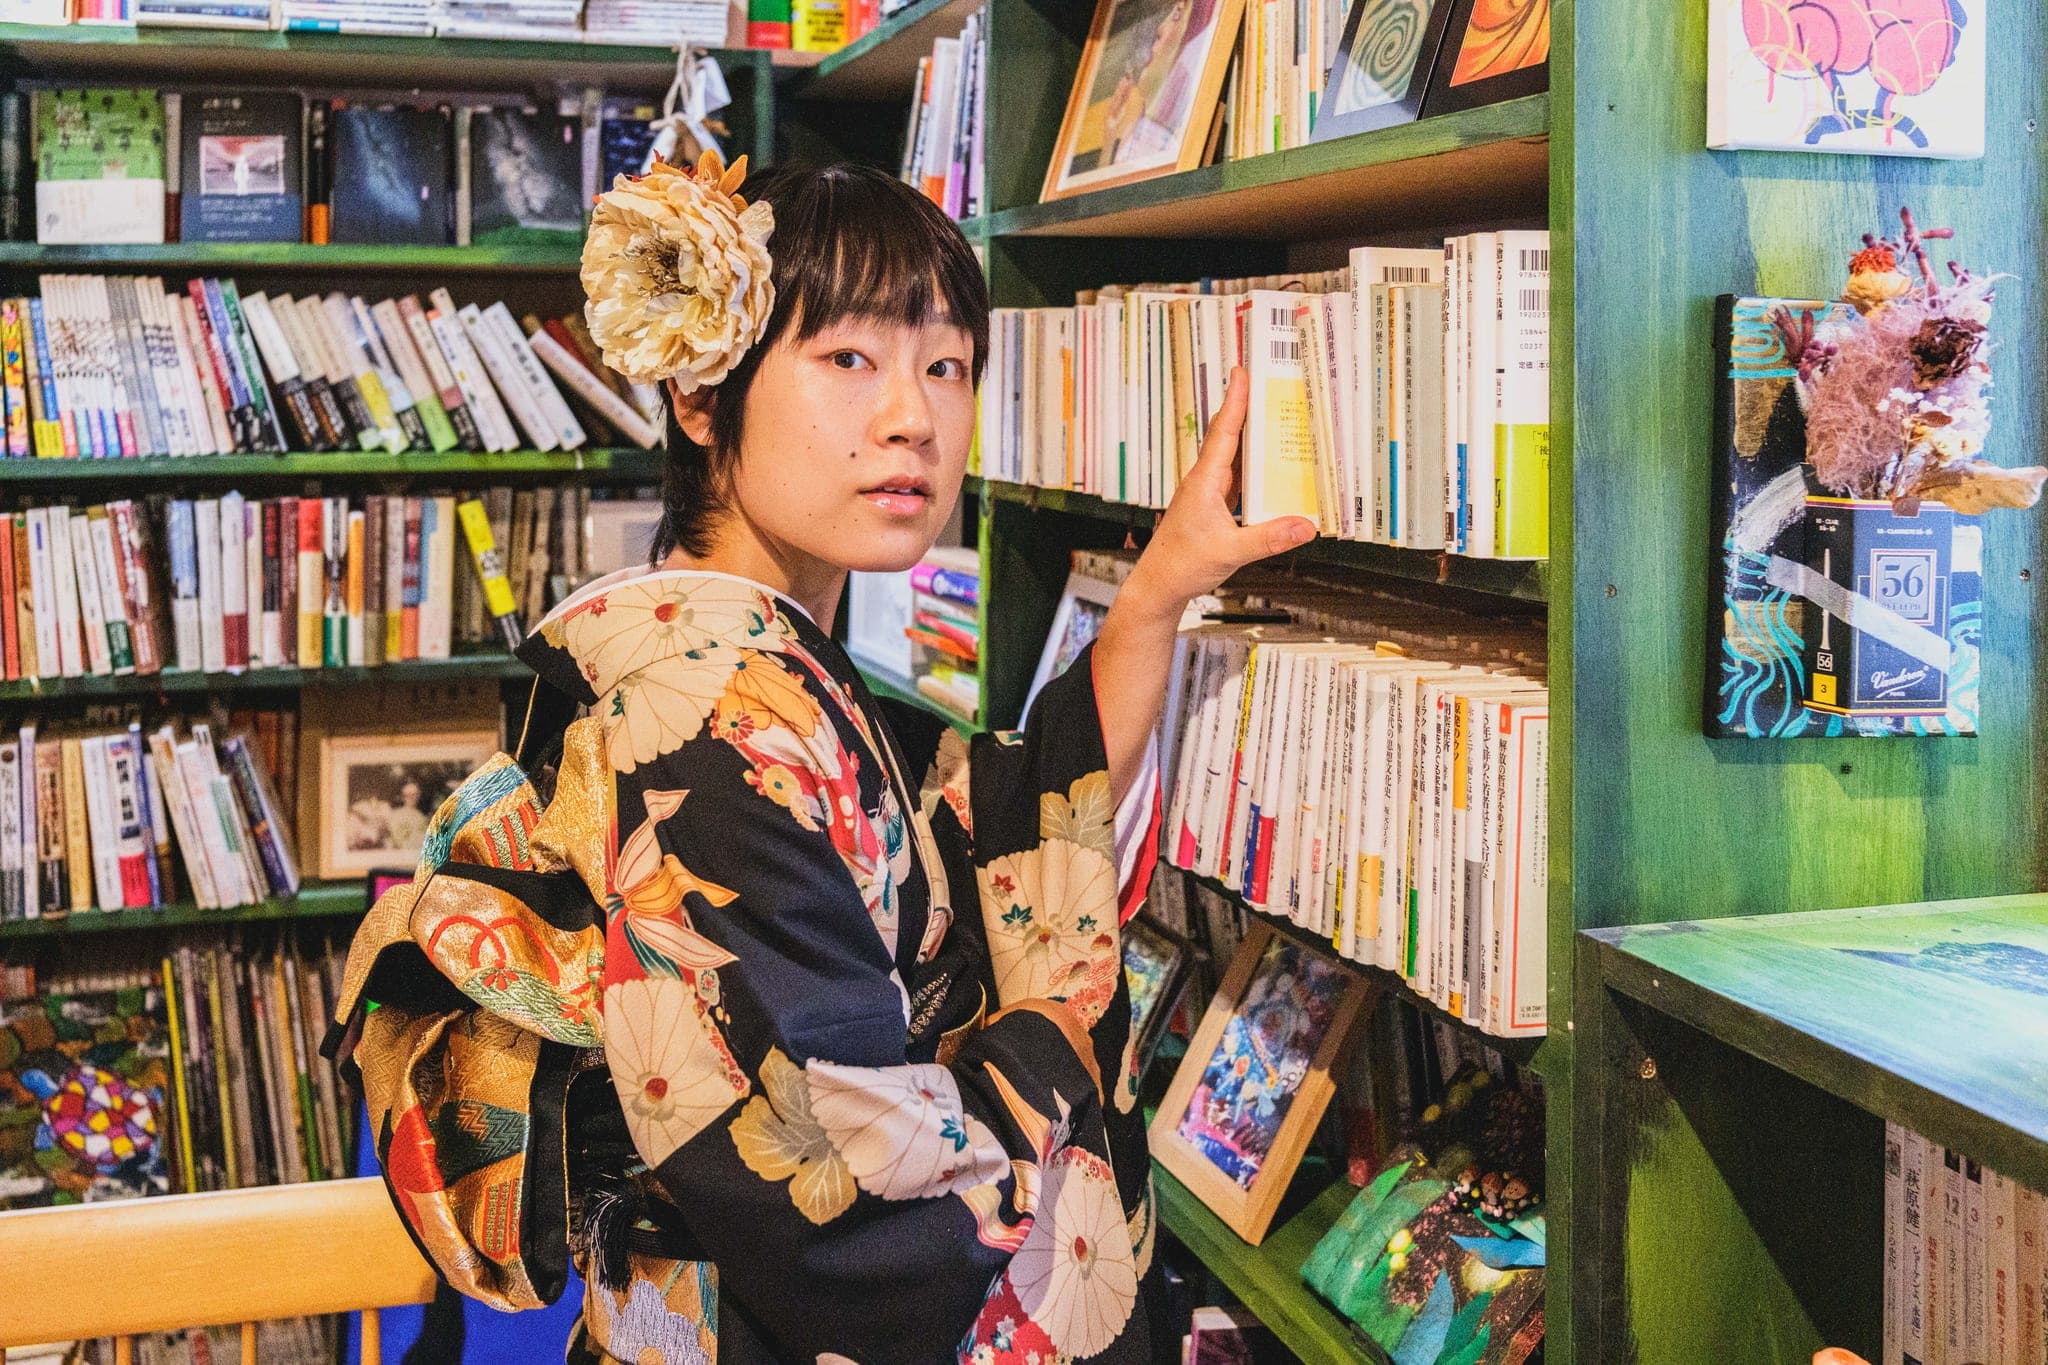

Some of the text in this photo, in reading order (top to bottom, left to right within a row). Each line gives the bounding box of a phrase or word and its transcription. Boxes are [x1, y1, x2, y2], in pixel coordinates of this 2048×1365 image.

[1325, 302, 1338, 379] 八十日間世界一周
[1881, 564, 1924, 598] 56
[1819, 655, 1831, 668] 56
[1820, 684, 1827, 694] 3
